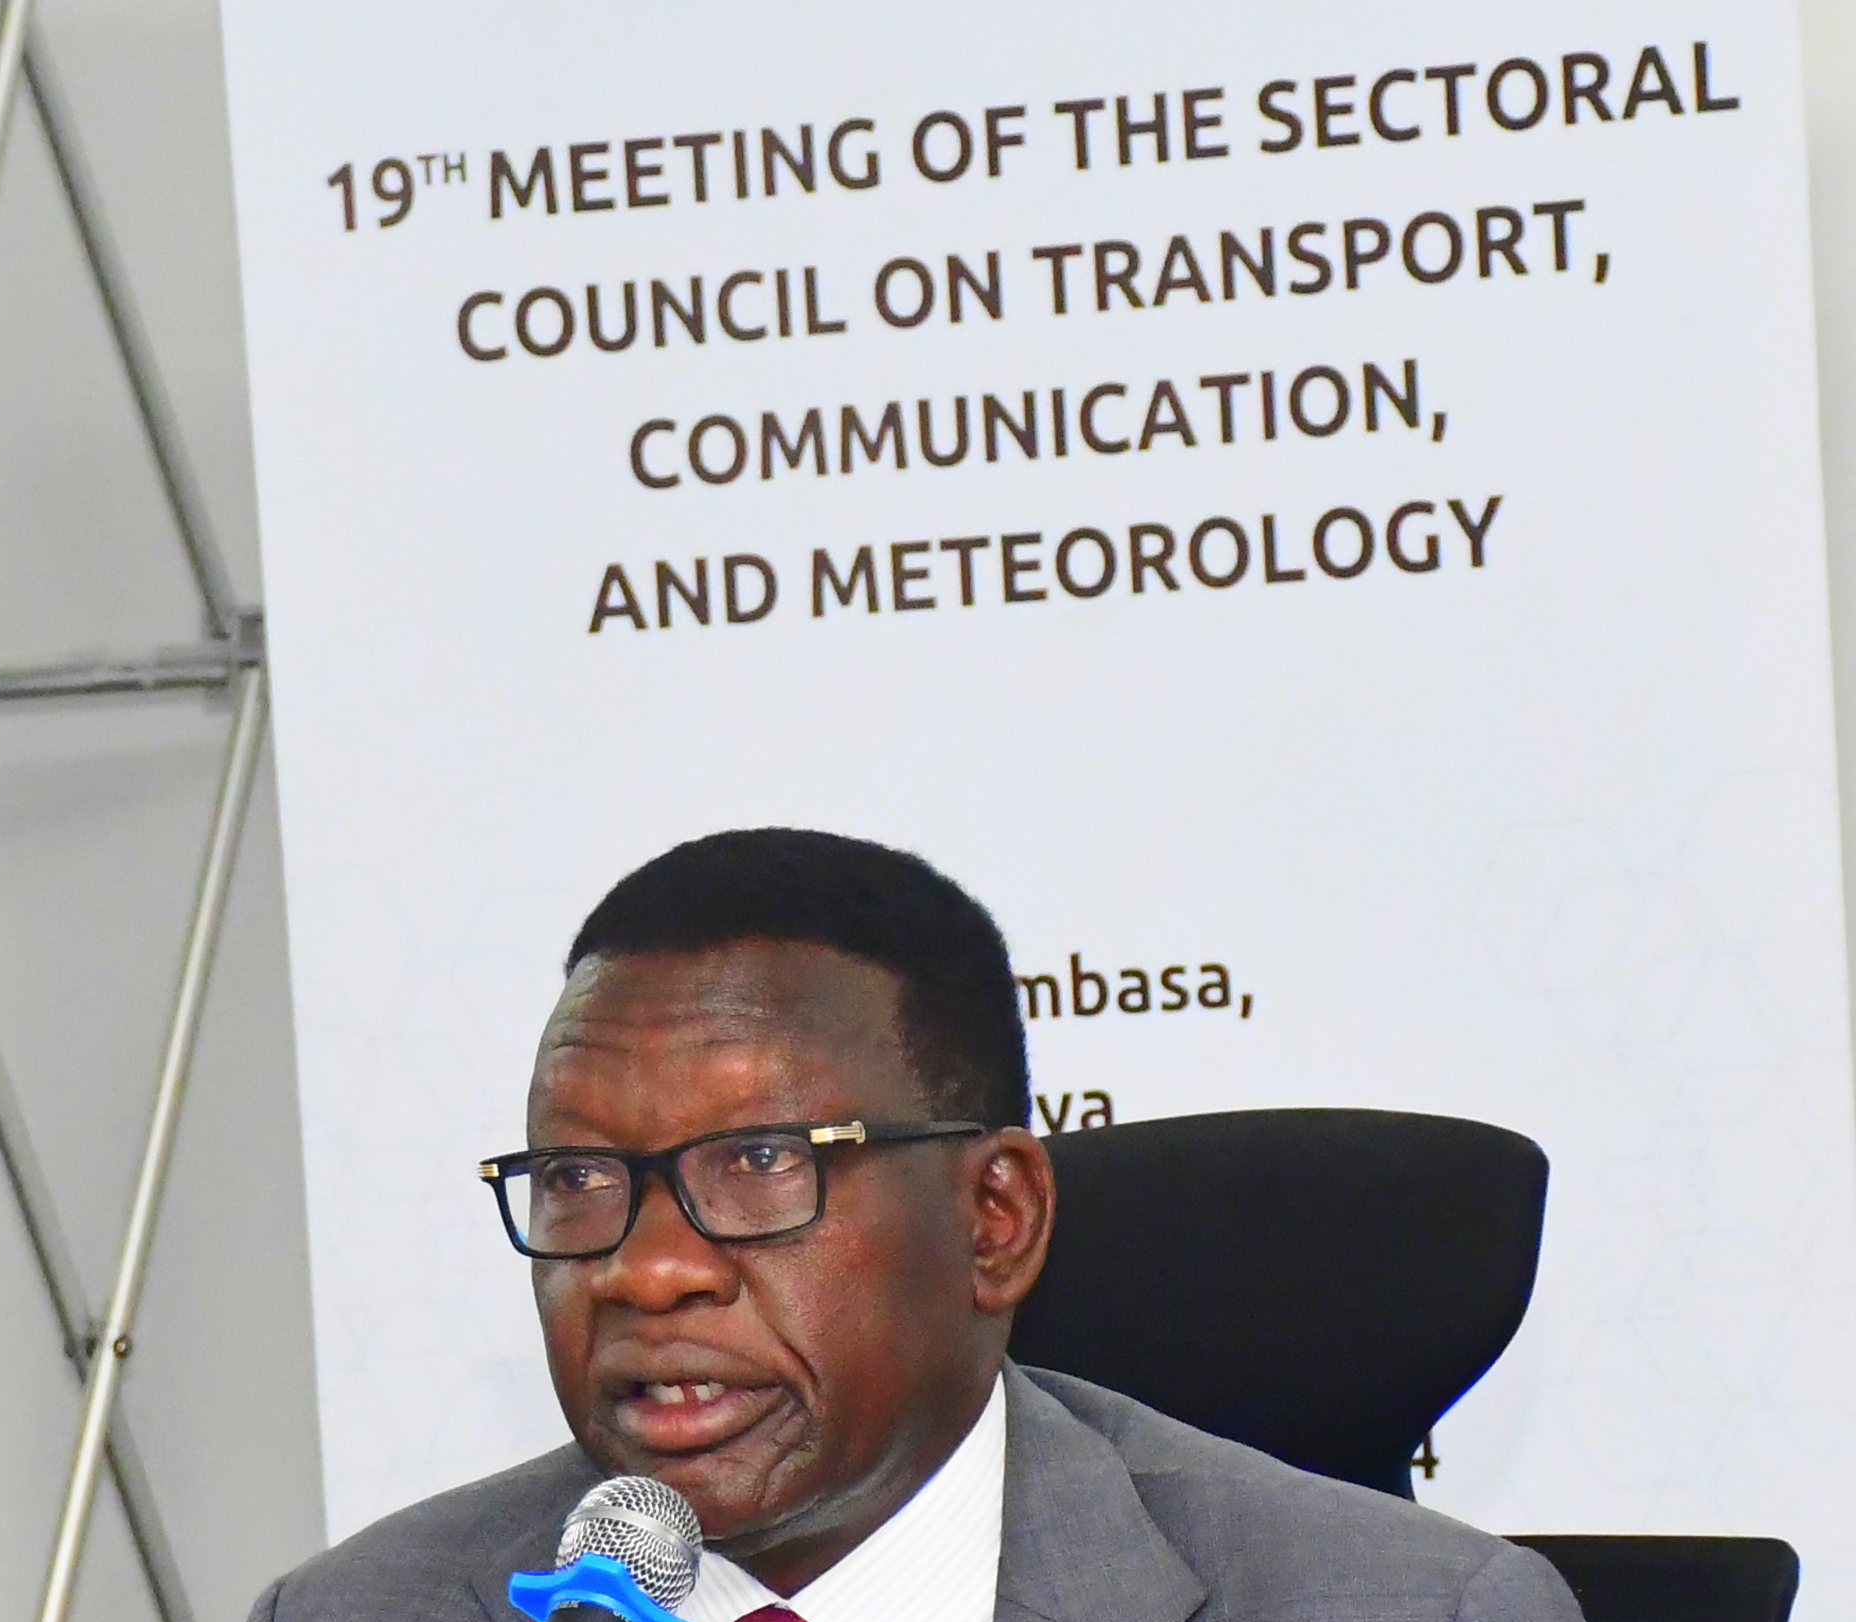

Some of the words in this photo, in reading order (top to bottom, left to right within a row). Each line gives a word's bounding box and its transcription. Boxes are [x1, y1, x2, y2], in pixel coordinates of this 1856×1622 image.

[489, 118, 880, 220] MEETING
[911, 105, 1026, 184] OF
[1053, 87, 1230, 171] THE
[1257, 41, 1740, 154] SECTORAL
[457, 266, 847, 363] COUNCIL
[874, 251, 1002, 329] ON
[1031, 199, 1610, 316] TRANSPORT,
[629, 358, 1446, 490] COMMUNICATION,
[588, 553, 778, 634] AND
[811, 495, 1502, 618] METEOROLOGY
[1016, 951, 1253, 1020] mbasa,
